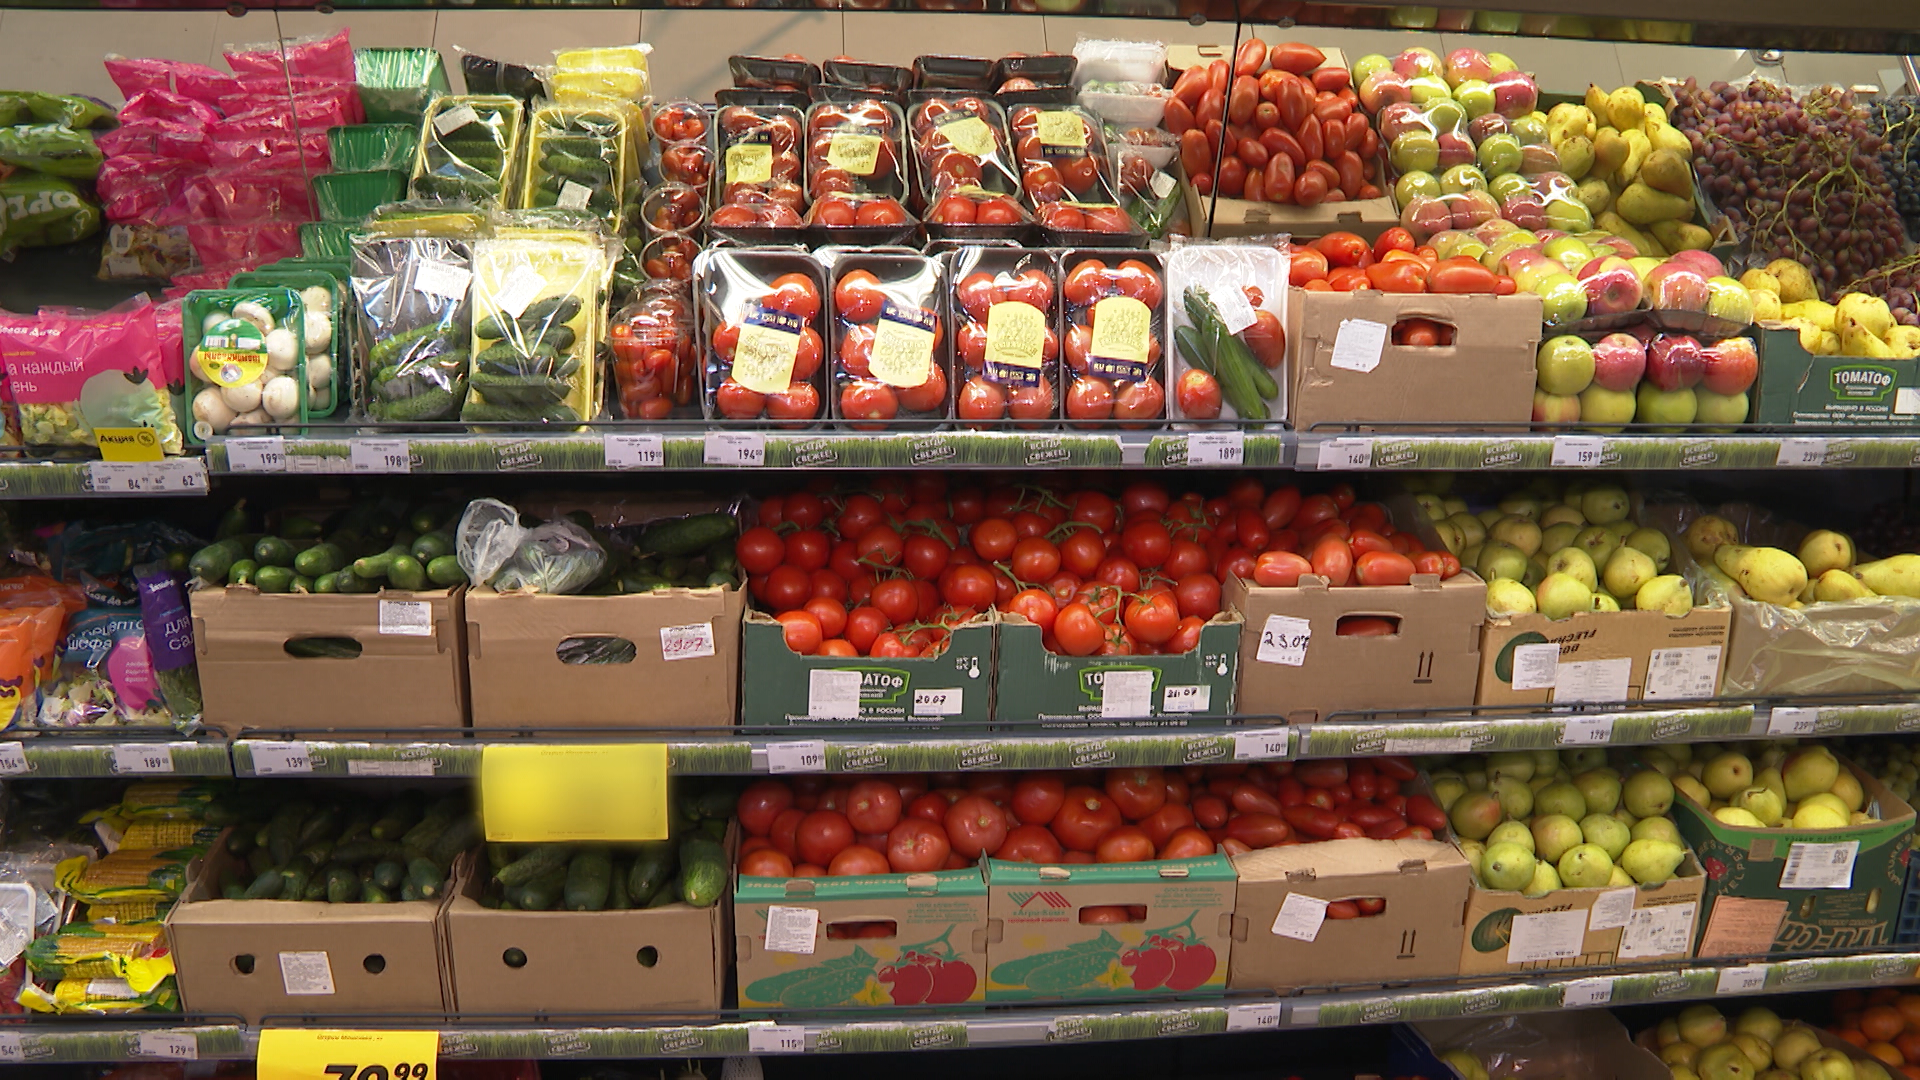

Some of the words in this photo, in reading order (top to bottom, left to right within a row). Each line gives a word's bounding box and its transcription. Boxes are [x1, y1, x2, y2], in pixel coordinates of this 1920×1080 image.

[22, 357, 85, 375] каждый
[1834, 371, 1891, 386] ТОМАТОФ
[100, 434, 135, 444] Акция
[260, 453, 277, 463] 199
[637, 451, 655, 462] 119
[738, 449, 756, 460] 194
[1218, 447, 1234, 460] 189
[1578, 451, 1592, 462] 159
[1802, 451, 1817, 462] 239
[384, 455, 402, 467] 198
[1348, 455, 1363, 464] 140
[128, 479, 140, 489] 84
[182, 475, 194, 486] 62
[1265, 743, 1280, 753] 140
[144, 758, 160, 767] 189
[286, 758, 302, 767] 139
[801, 755, 817, 765] 109
[1257, 1015, 1272, 1026] 140
[170, 1045, 186, 1054] 129
